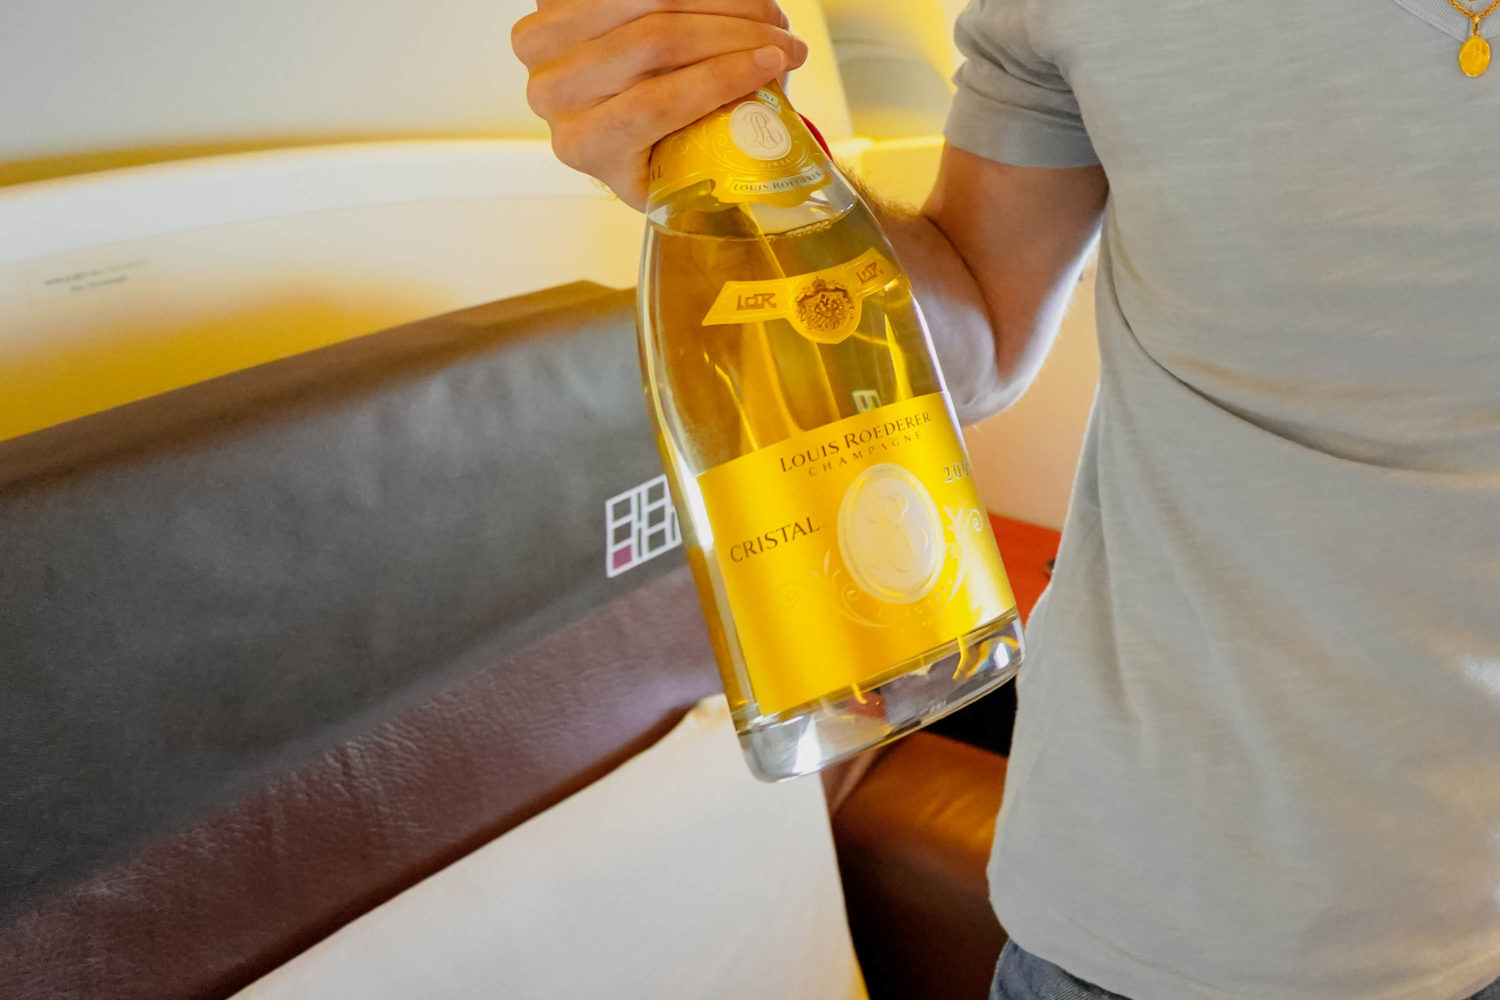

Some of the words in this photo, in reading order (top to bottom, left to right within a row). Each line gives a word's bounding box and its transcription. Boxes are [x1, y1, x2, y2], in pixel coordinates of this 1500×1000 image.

[780, 441, 840, 473] LOUIS
[844, 411, 932, 449] ROEDERER
[808, 430, 922, 477] CHAMPAGNE
[730, 516, 821, 563] CRISTAL
